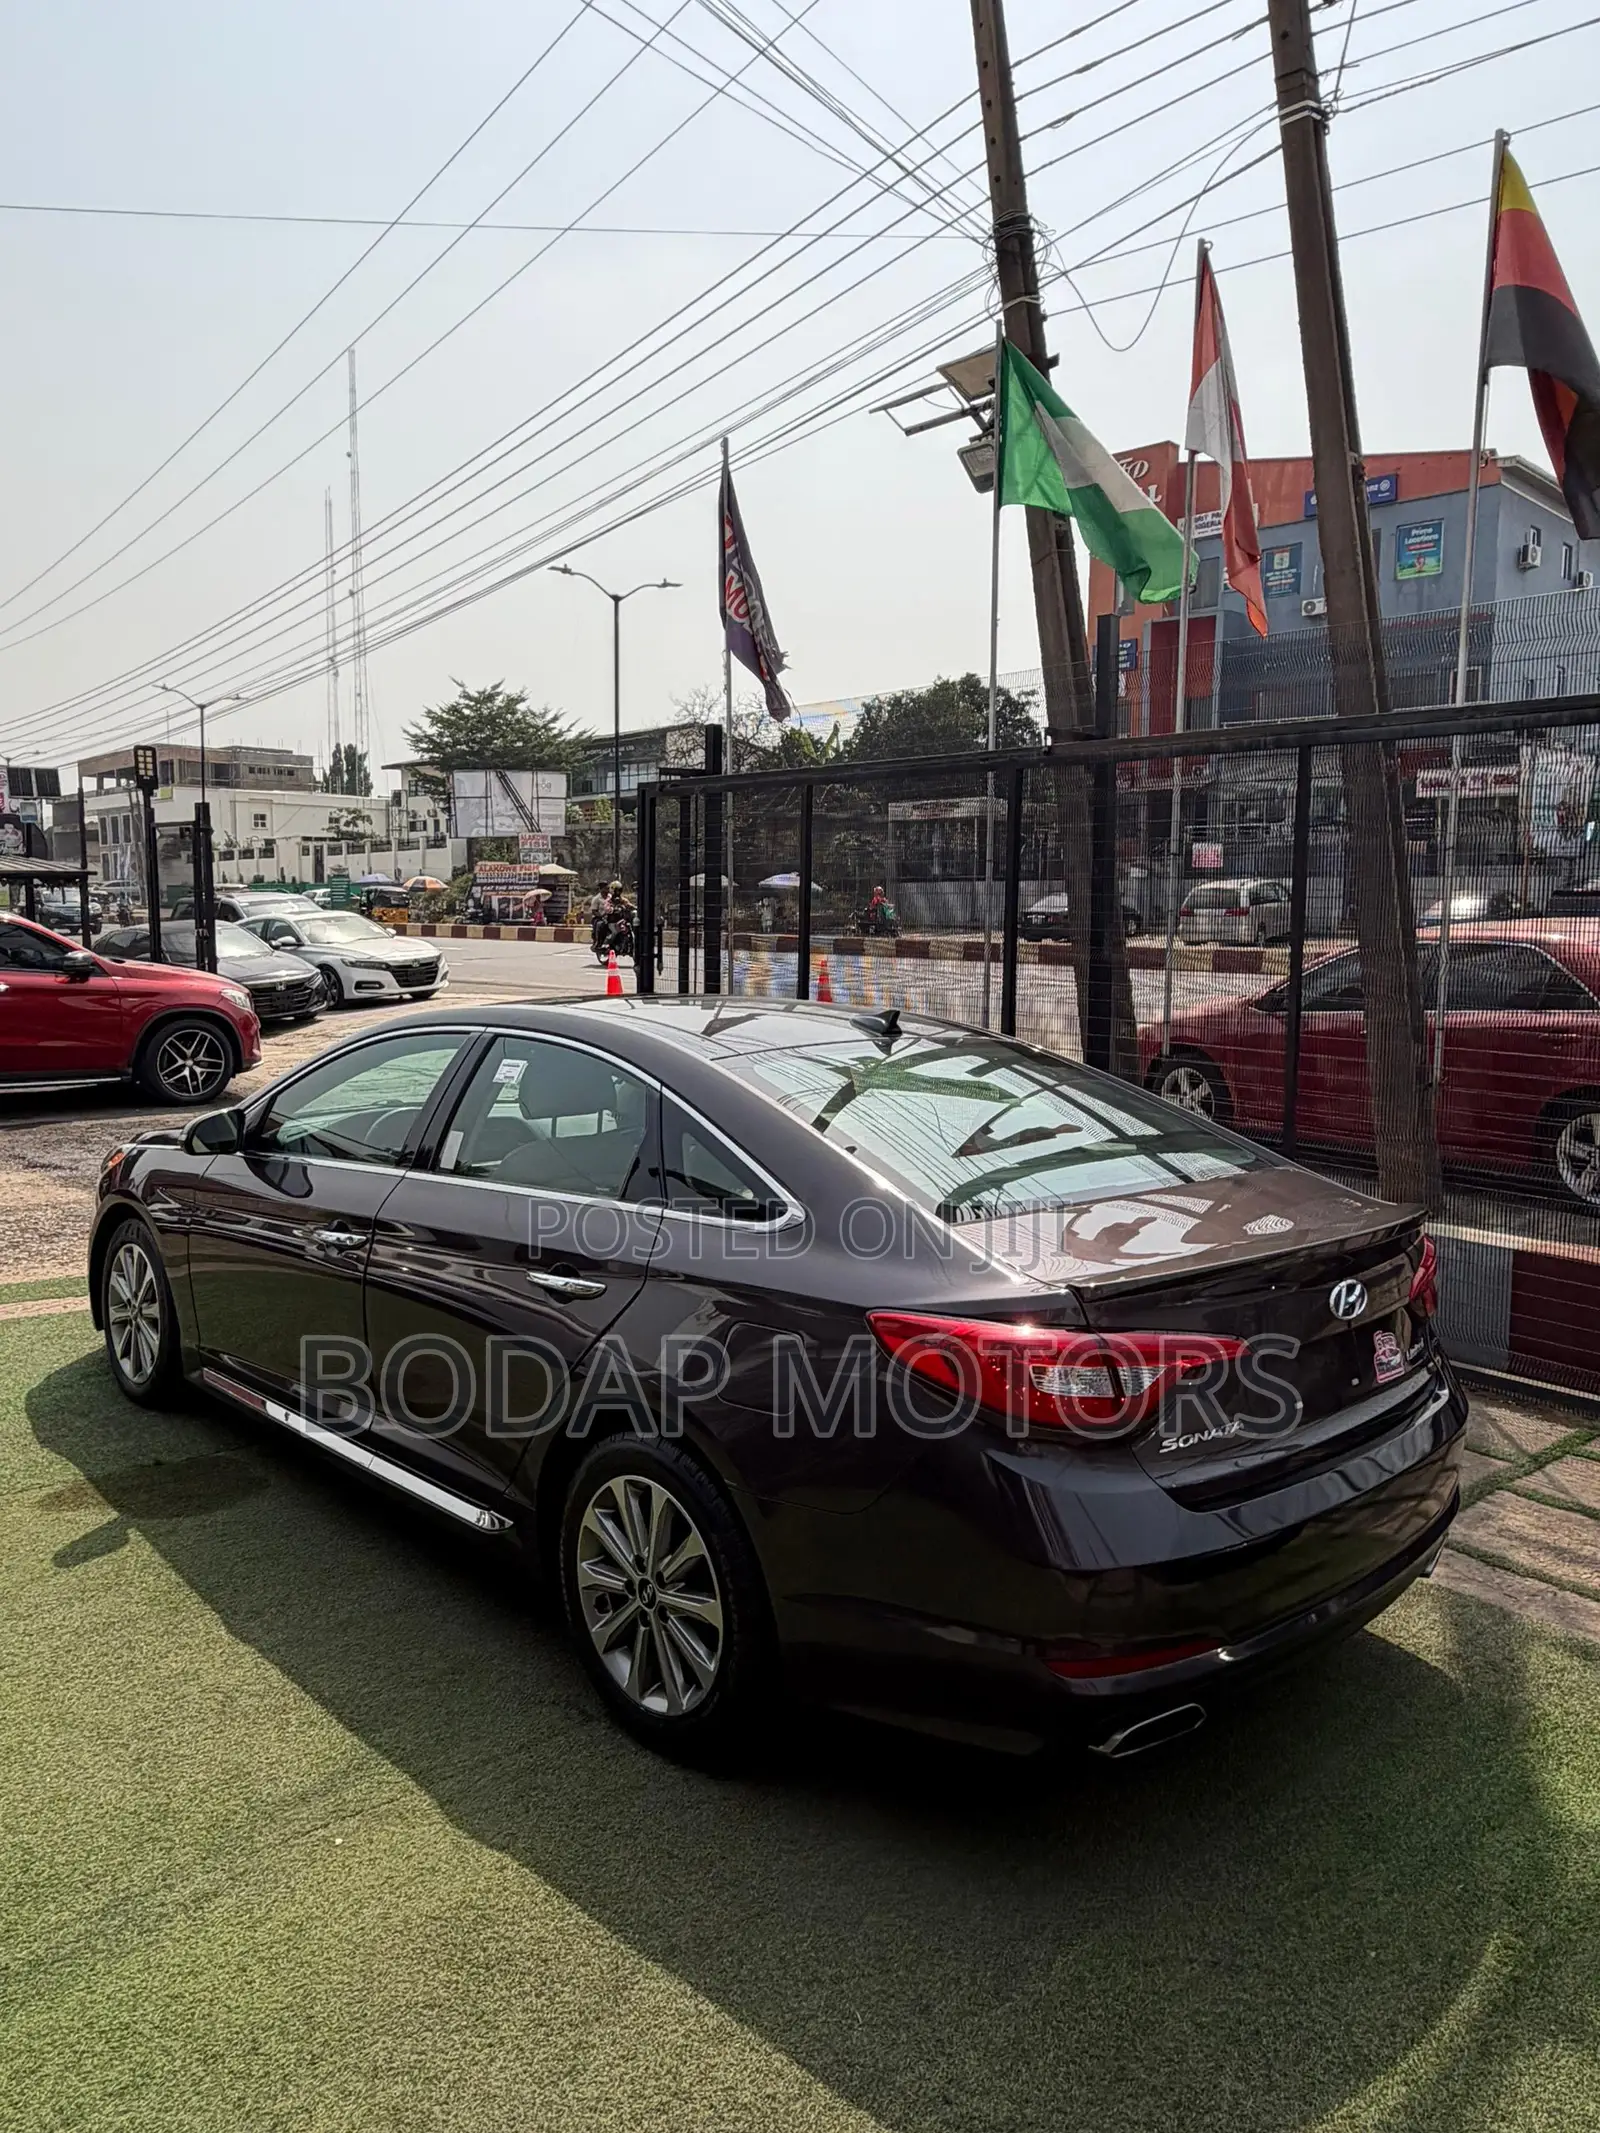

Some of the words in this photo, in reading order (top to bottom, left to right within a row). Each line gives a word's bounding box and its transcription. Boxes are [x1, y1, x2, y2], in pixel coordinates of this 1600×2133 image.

[1411, 527, 1433, 536] Prime
[1404, 534, 1439, 544] Locations
[520, 840, 549, 848] FISH
[1159, 1420, 1245, 1454] SONATA
